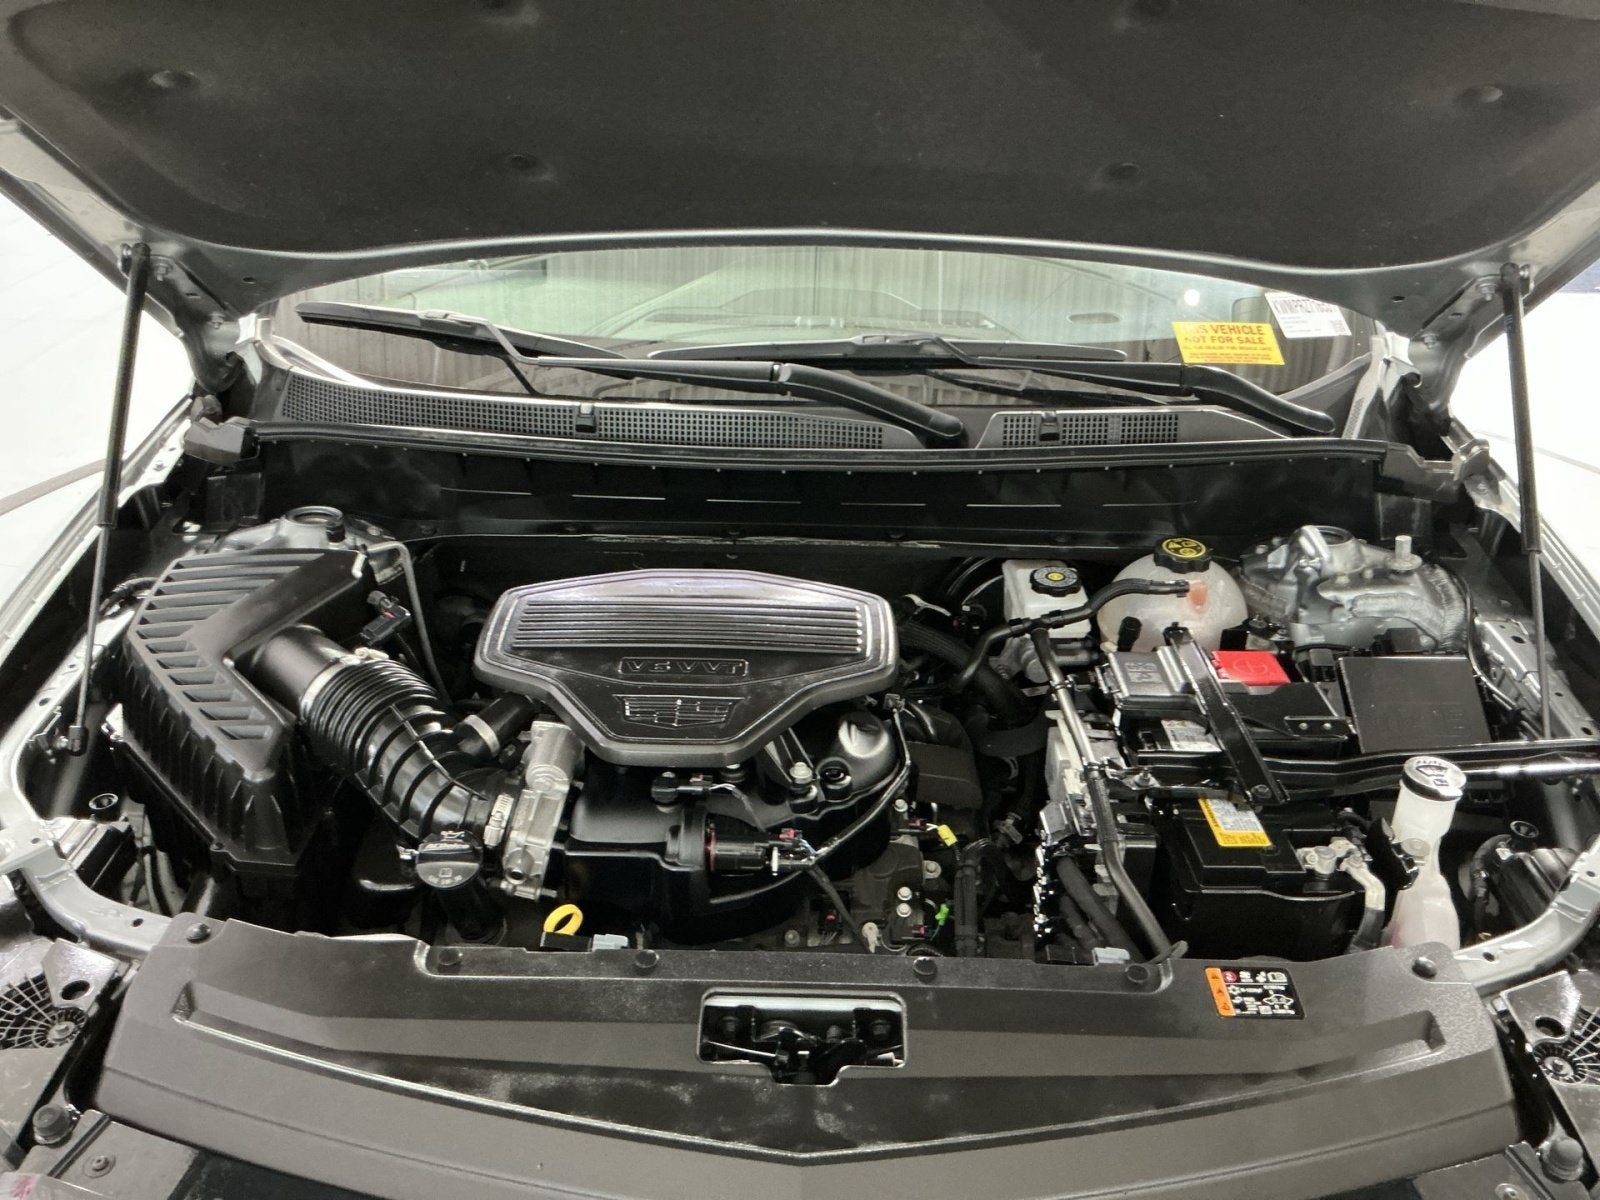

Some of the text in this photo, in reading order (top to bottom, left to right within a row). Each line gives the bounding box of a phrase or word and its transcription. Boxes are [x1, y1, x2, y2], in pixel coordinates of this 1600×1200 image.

[1211, 324, 1266, 336] VEHICLE
[1210, 336, 1233, 344] FOR
[1237, 337, 1266, 345] SALE
[677, 660, 743, 675] VVT
